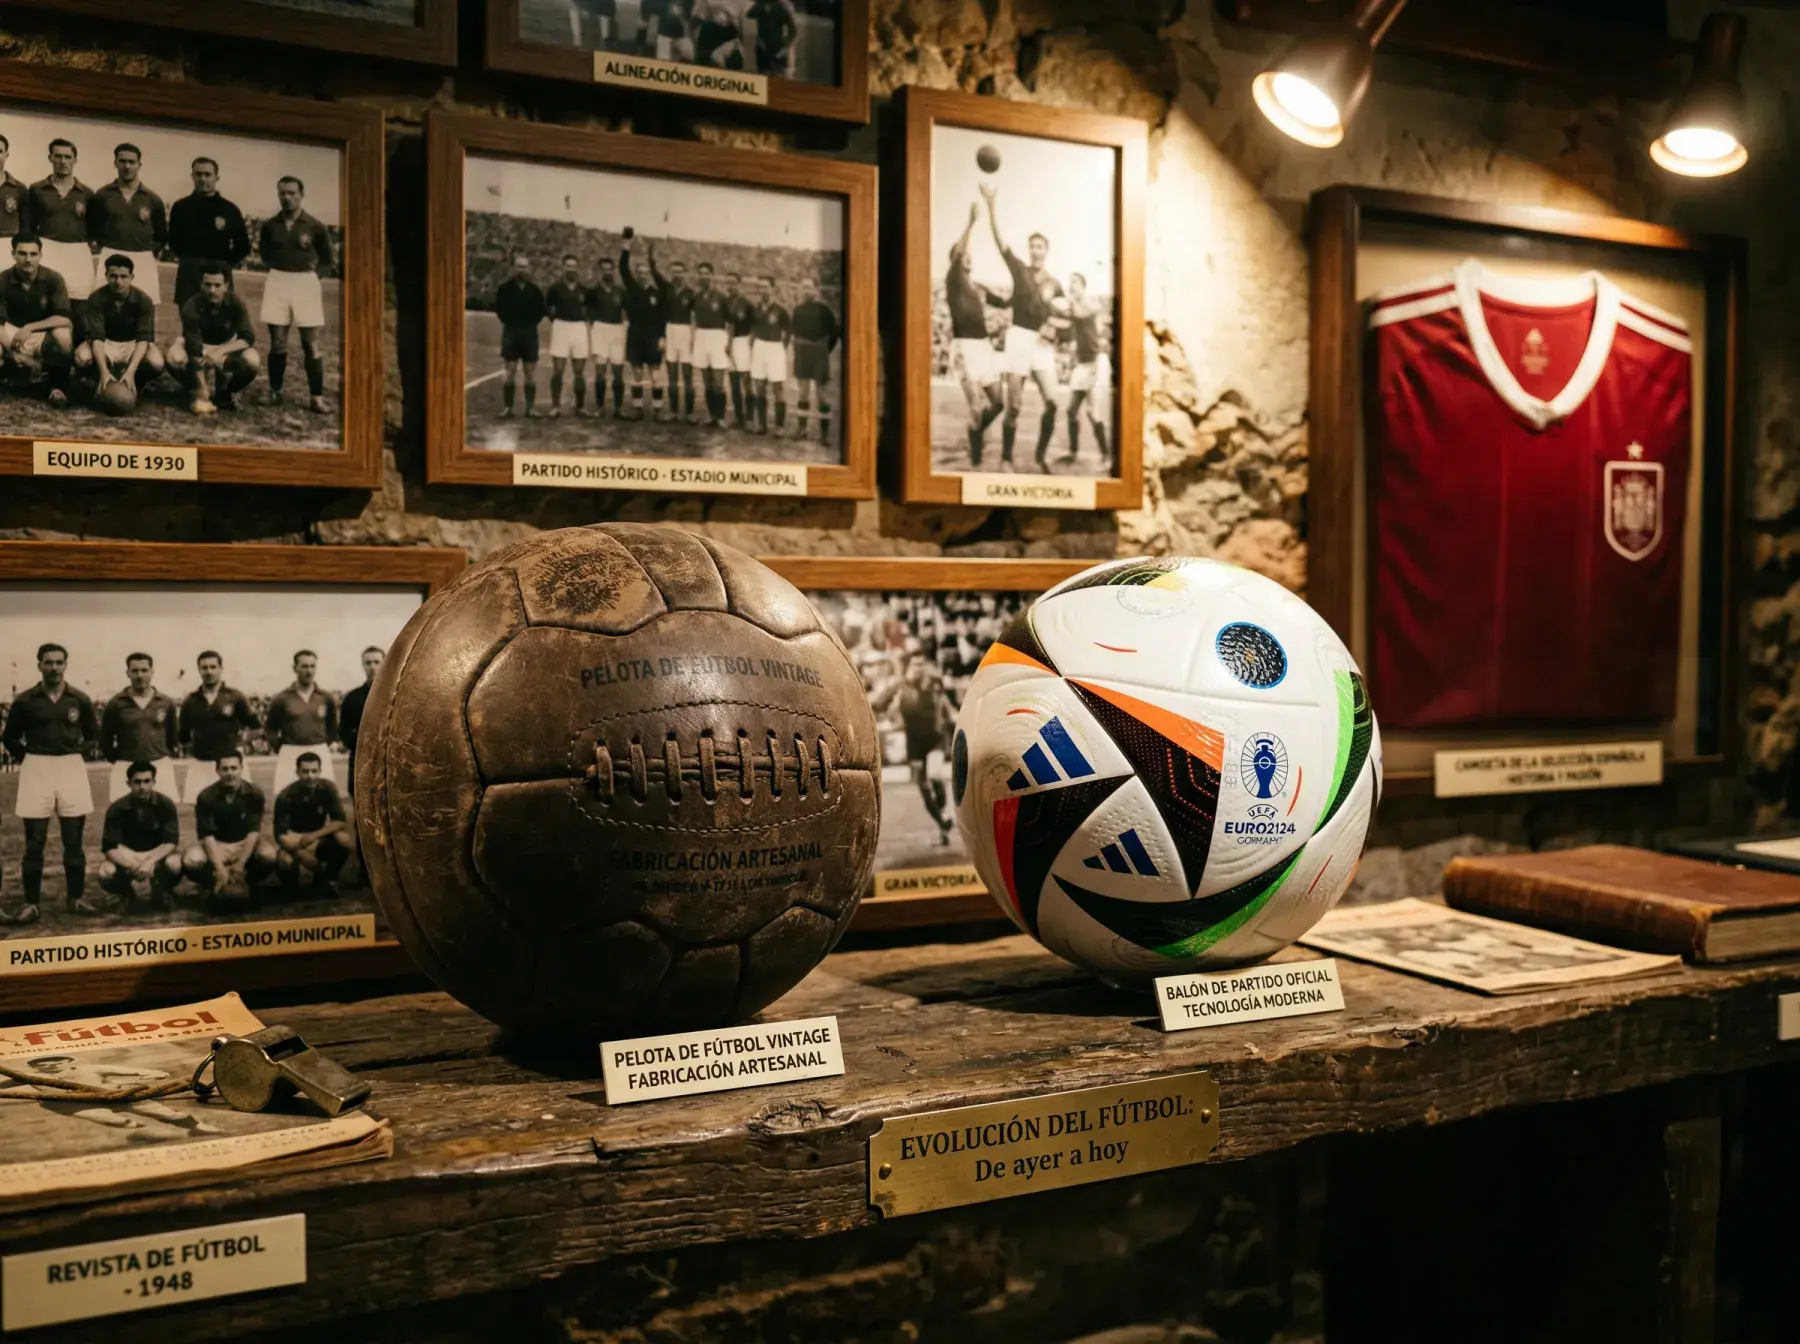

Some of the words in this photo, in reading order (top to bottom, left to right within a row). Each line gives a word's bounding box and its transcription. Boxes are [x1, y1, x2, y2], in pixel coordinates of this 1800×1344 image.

[605, 61, 691, 86] ALINEACIÓN
[694, 75, 759, 96] ORIGINAL
[48, 452, 112, 468] EQUIPO
[118, 455, 139, 469] DE
[144, 456, 185, 471] 1930
[522, 463, 582, 479] PARTIDO
[586, 464, 658, 481] HISTÓRICO
[671, 469, 726, 483] ESTADIO
[729, 472, 798, 487] MUNICIPAL
[987, 484, 1018, 496] GRAN
[1022, 486, 1074, 499] VICTORIA
[580, 659, 656, 689] PELOTA
[658, 656, 686, 676] DE
[760, 659, 824, 689] VINTAGE
[1224, 822, 1296, 834] EURO2124
[1248, 807, 1275, 819] UEFA
[608, 845, 731, 871] FABRICACIÓN
[736, 840, 823, 869] ARTESANAL
[884, 878, 918, 891] GRAN
[10, 946, 89, 965] PARTIDO
[94, 938, 187, 960] HISTÓRICO
[202, 931, 273, 951] ESTADIO
[276, 925, 366, 945] MUNICIPAL
[1166, 981, 1209, 1000] BALÓN
[1212, 980, 1229, 995] DE
[1231, 974, 1283, 992] PARTIDO
[1286, 969, 1332, 986] OFICIAL
[1183, 994, 1262, 1018] TECNOLOGÍA
[1264, 990, 1325, 1008] MODERNA
[24, 1011, 219, 1045] Fútbol
[614, 1046, 676, 1068] PELOTA
[679, 1044, 700, 1061] DE
[703, 1037, 765, 1057] FÚTBOL
[766, 1028, 831, 1049] VINTAGE
[628, 1061, 735, 1089] FABRICACIÓN
[738, 1051, 827, 1076] ARTESANAL
[900, 1114, 1041, 1160] EVOLUCIÓN
[1048, 1113, 1093, 1138] DEL
[1099, 1095, 1194, 1129] FÚTBOL:
[975, 1159, 1006, 1182] De
[1013, 1151, 1064, 1181] ayer
[1070, 1147, 1083, 1165] a
[1088, 1139, 1130, 1164] hoy
[47, 1252, 141, 1284] REVISTA
[146, 1248, 175, 1268] DE
[181, 1235, 265, 1263] FÚTBOL
[139, 1271, 193, 1297] 1948
